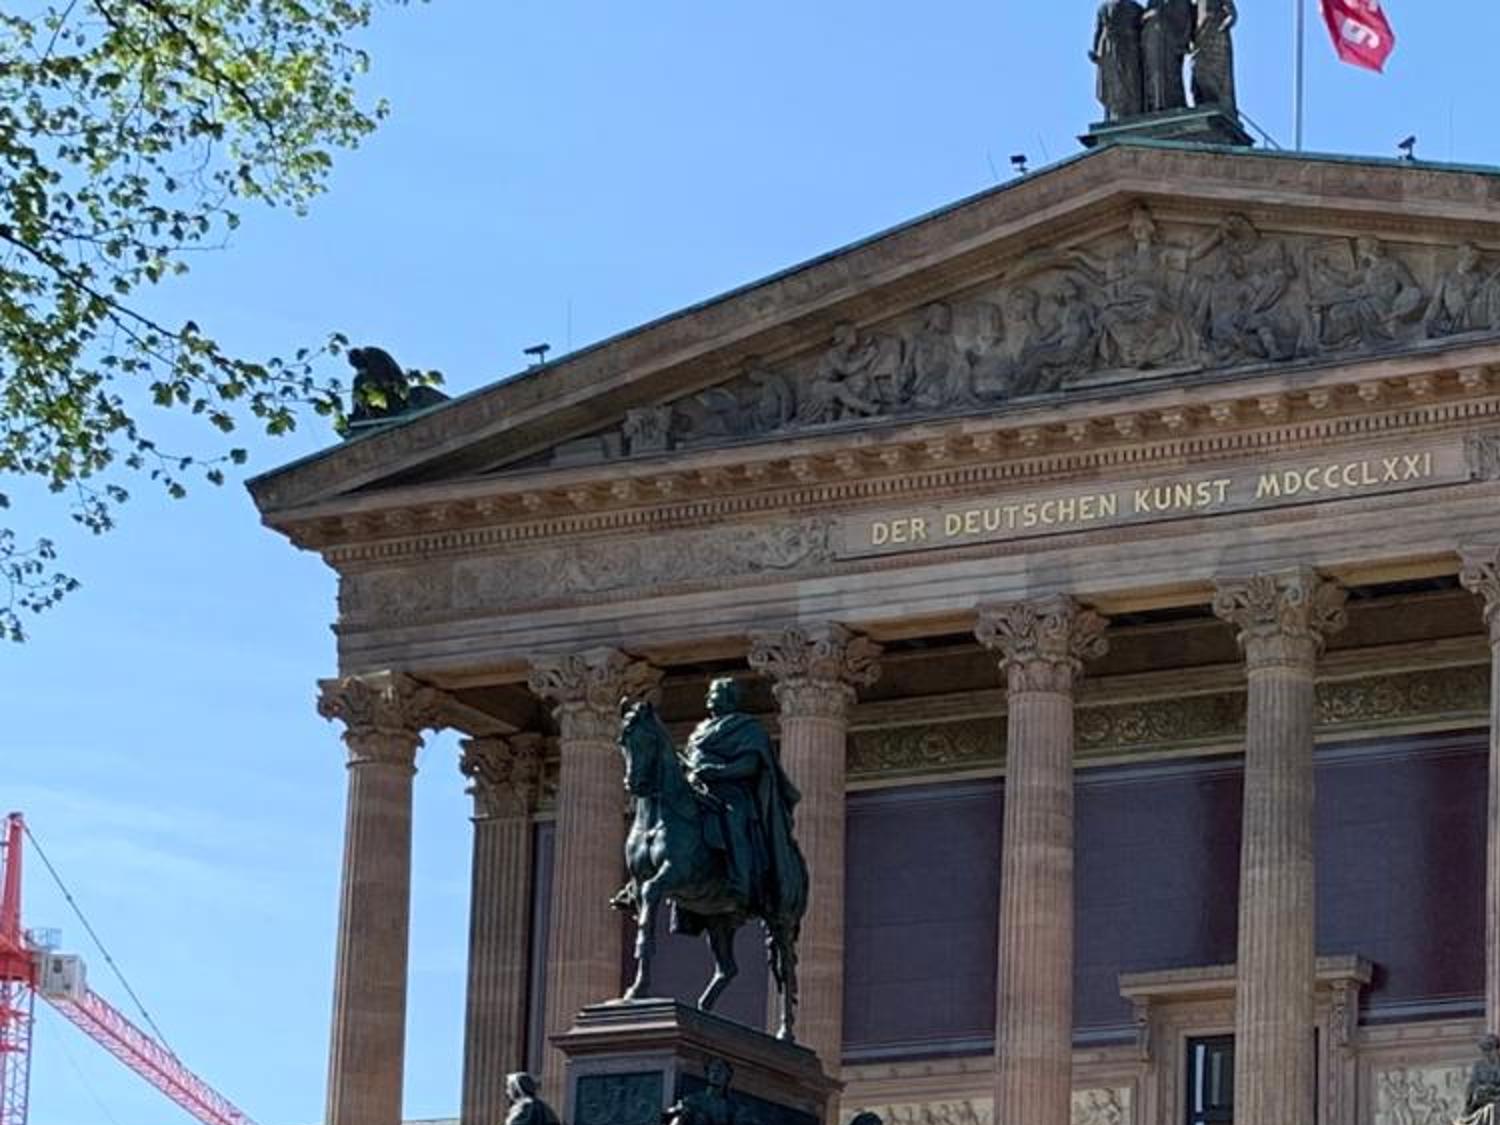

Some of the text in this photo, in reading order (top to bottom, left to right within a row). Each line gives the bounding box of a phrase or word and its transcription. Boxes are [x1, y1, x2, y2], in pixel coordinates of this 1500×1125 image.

[871, 452, 1432, 546] DER DEUTSCHEN KUNST MDCCCLXXI
